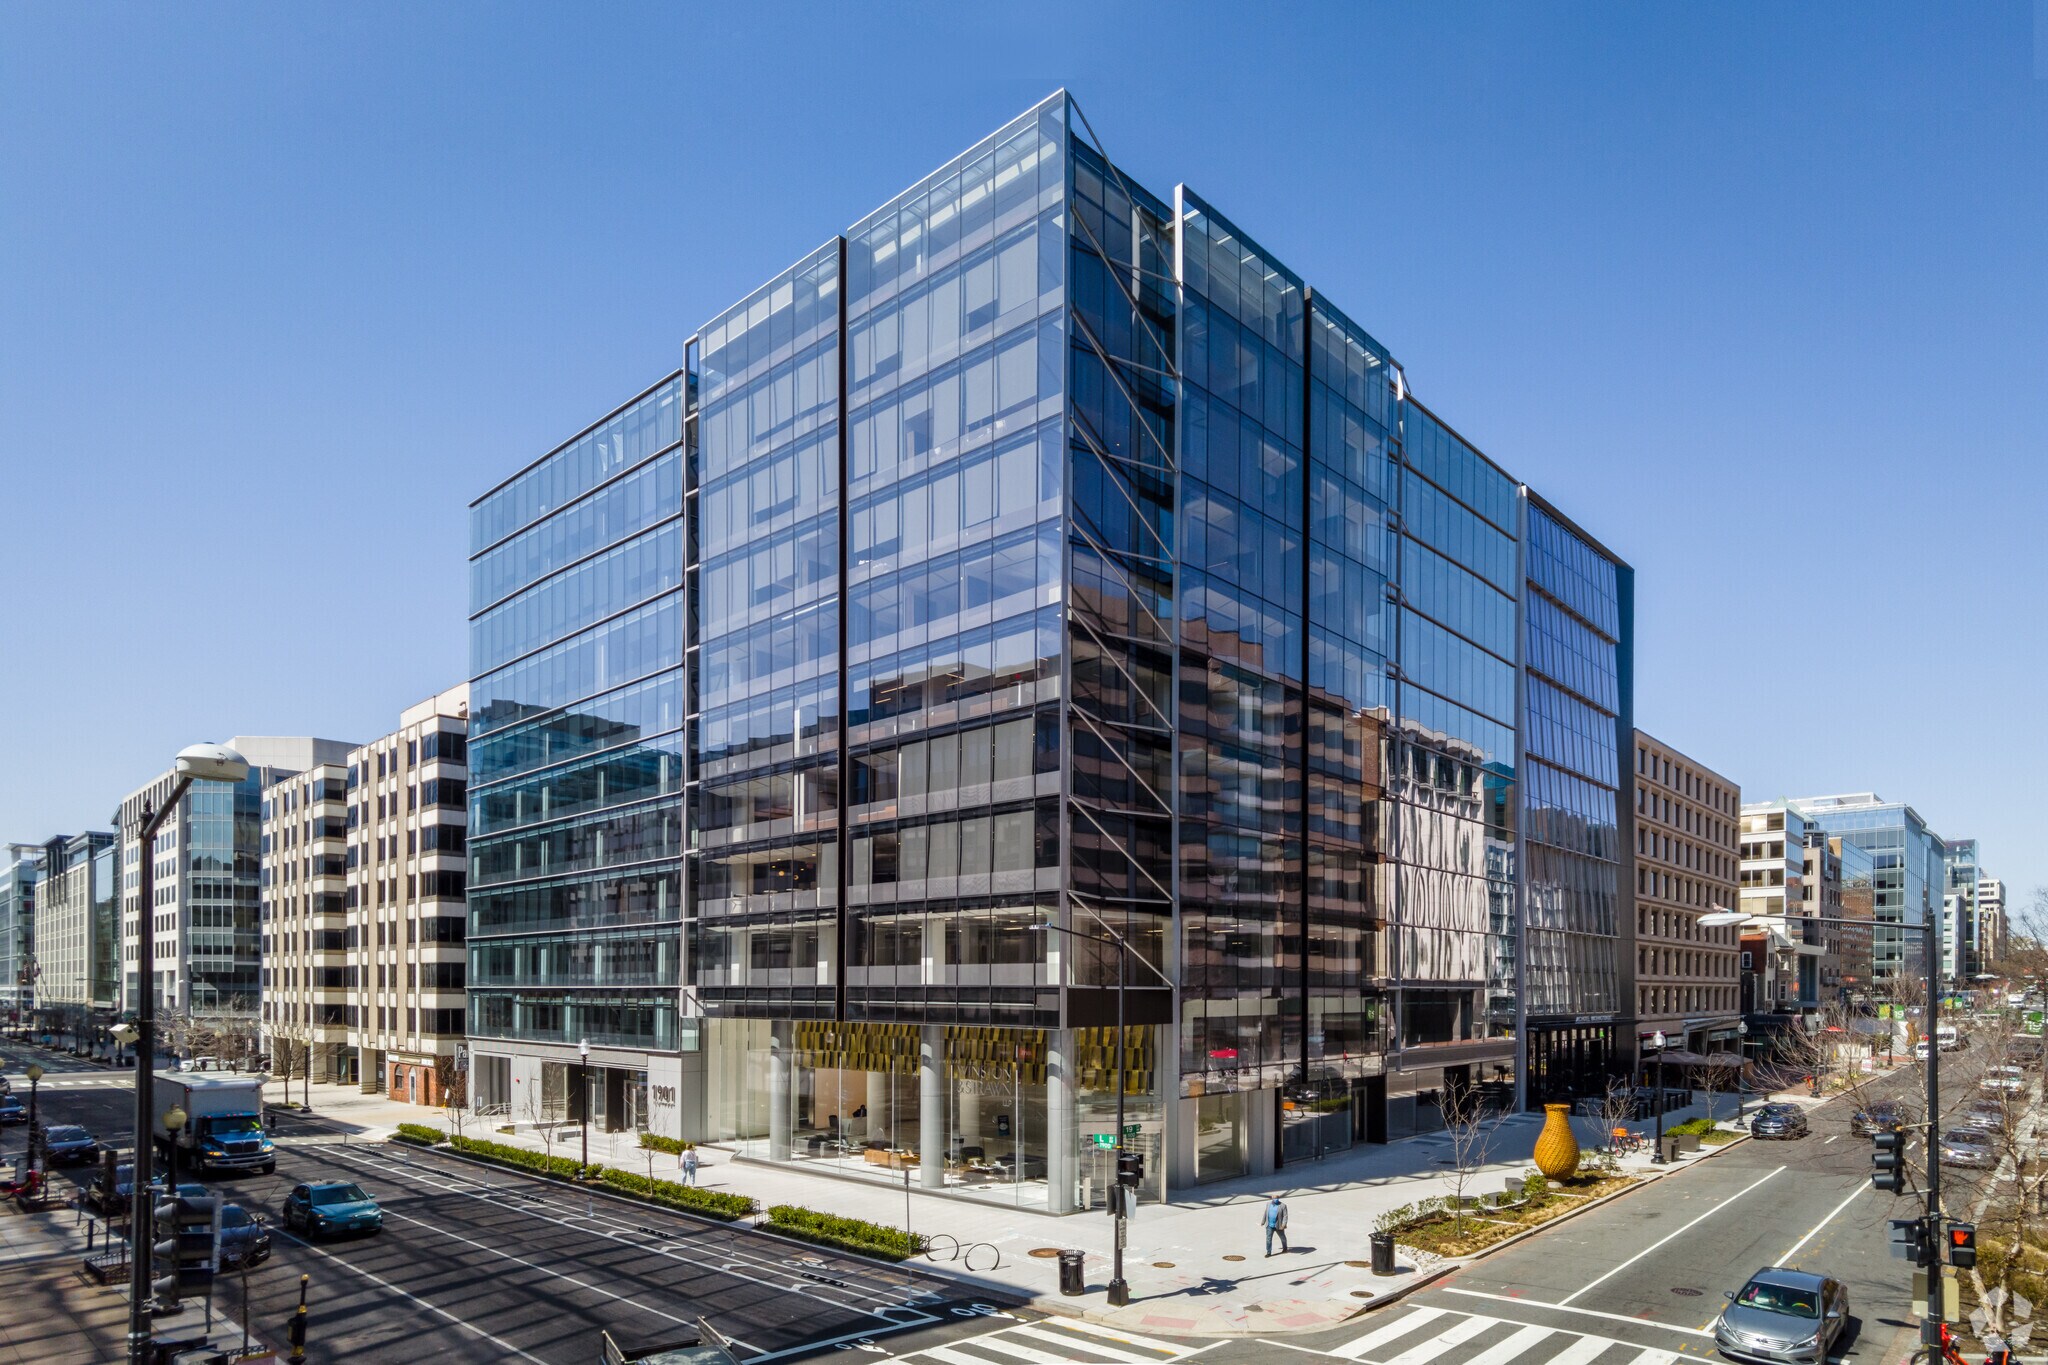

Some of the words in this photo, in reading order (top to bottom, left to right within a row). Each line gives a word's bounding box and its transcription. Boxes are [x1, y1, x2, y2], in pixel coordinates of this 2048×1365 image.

[957, 1064, 1012, 1080] WINSTON
[652, 1084, 676, 1102] 1901
[1099, 1134, 1104, 1143] L
